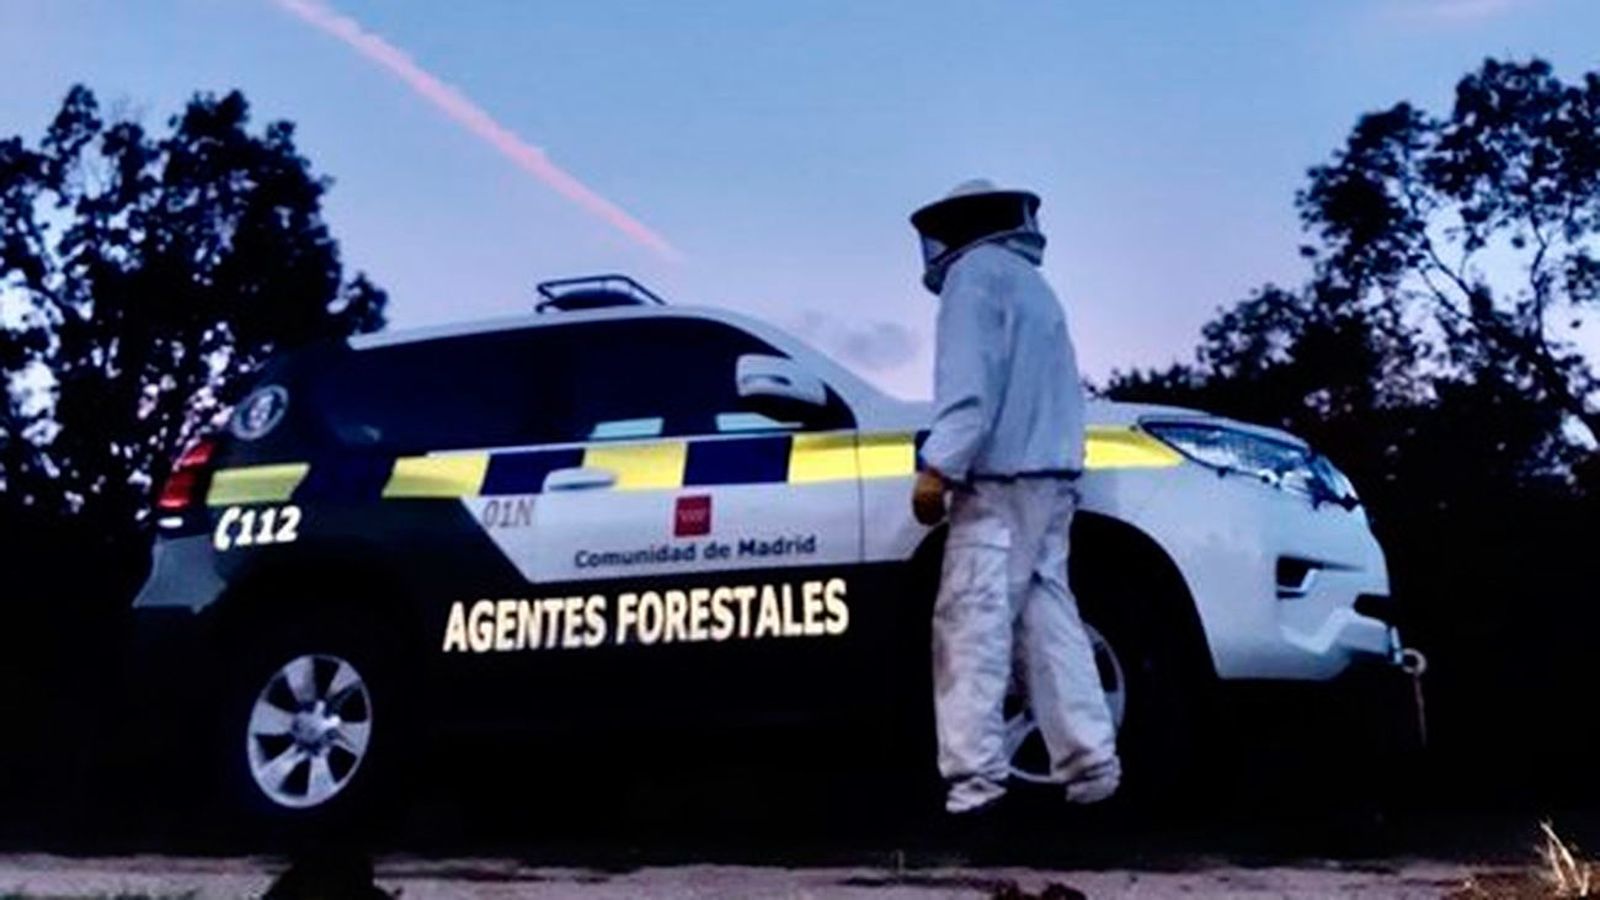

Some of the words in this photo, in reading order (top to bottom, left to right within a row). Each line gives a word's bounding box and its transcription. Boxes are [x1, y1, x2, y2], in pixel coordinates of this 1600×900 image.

[483, 499, 535, 527] 01N
[575, 544, 697, 568] Comunidad
[704, 542, 731, 560] de
[737, 536, 817, 557] Madrid
[443, 594, 607, 652] AGENTES
[616, 578, 850, 645] FORESTALES
